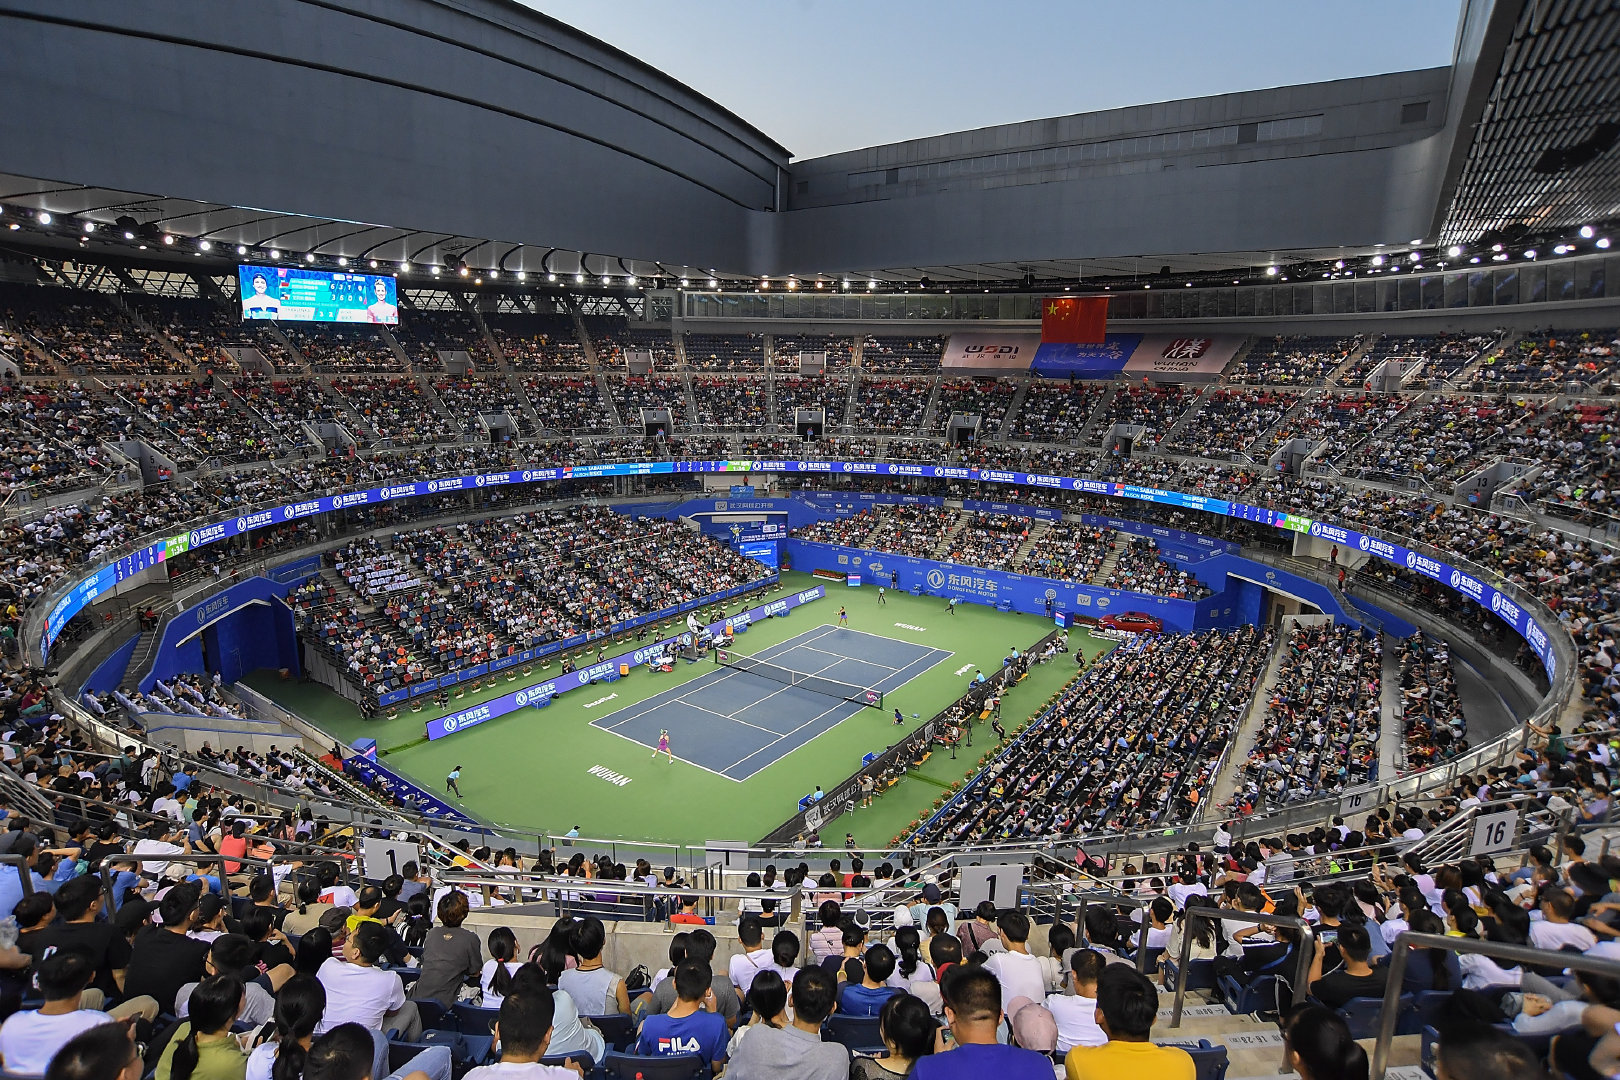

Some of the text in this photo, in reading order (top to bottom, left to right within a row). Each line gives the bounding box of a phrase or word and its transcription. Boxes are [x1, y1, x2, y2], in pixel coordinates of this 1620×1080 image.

[964, 346, 1019, 354] WSDI
[1477, 478, 1487, 487] 13
[1290, 524, 1304, 532] 1:34
[117, 562, 122, 570] 6
[128, 556, 132, 565] 3
[149, 547, 153, 555] 0
[171, 546, 184, 556] 1:34
[119, 556, 154, 580] 3 6 0 0
[948, 574, 998, 591] 东风汽车
[948, 585, 976, 594] DONGFENG
[894, 622, 927, 632] WUHAN
[528, 682, 555, 698] 东风汽车
[458, 706, 489, 723] 东风汽车
[587, 764, 632, 787] WUHAN
[1350, 796, 1362, 808] 16
[1485, 820, 1506, 846] 16
[386, 850, 397, 875] 1
[985, 874, 997, 902] 1
[658, 1037, 701, 1052] FILA
